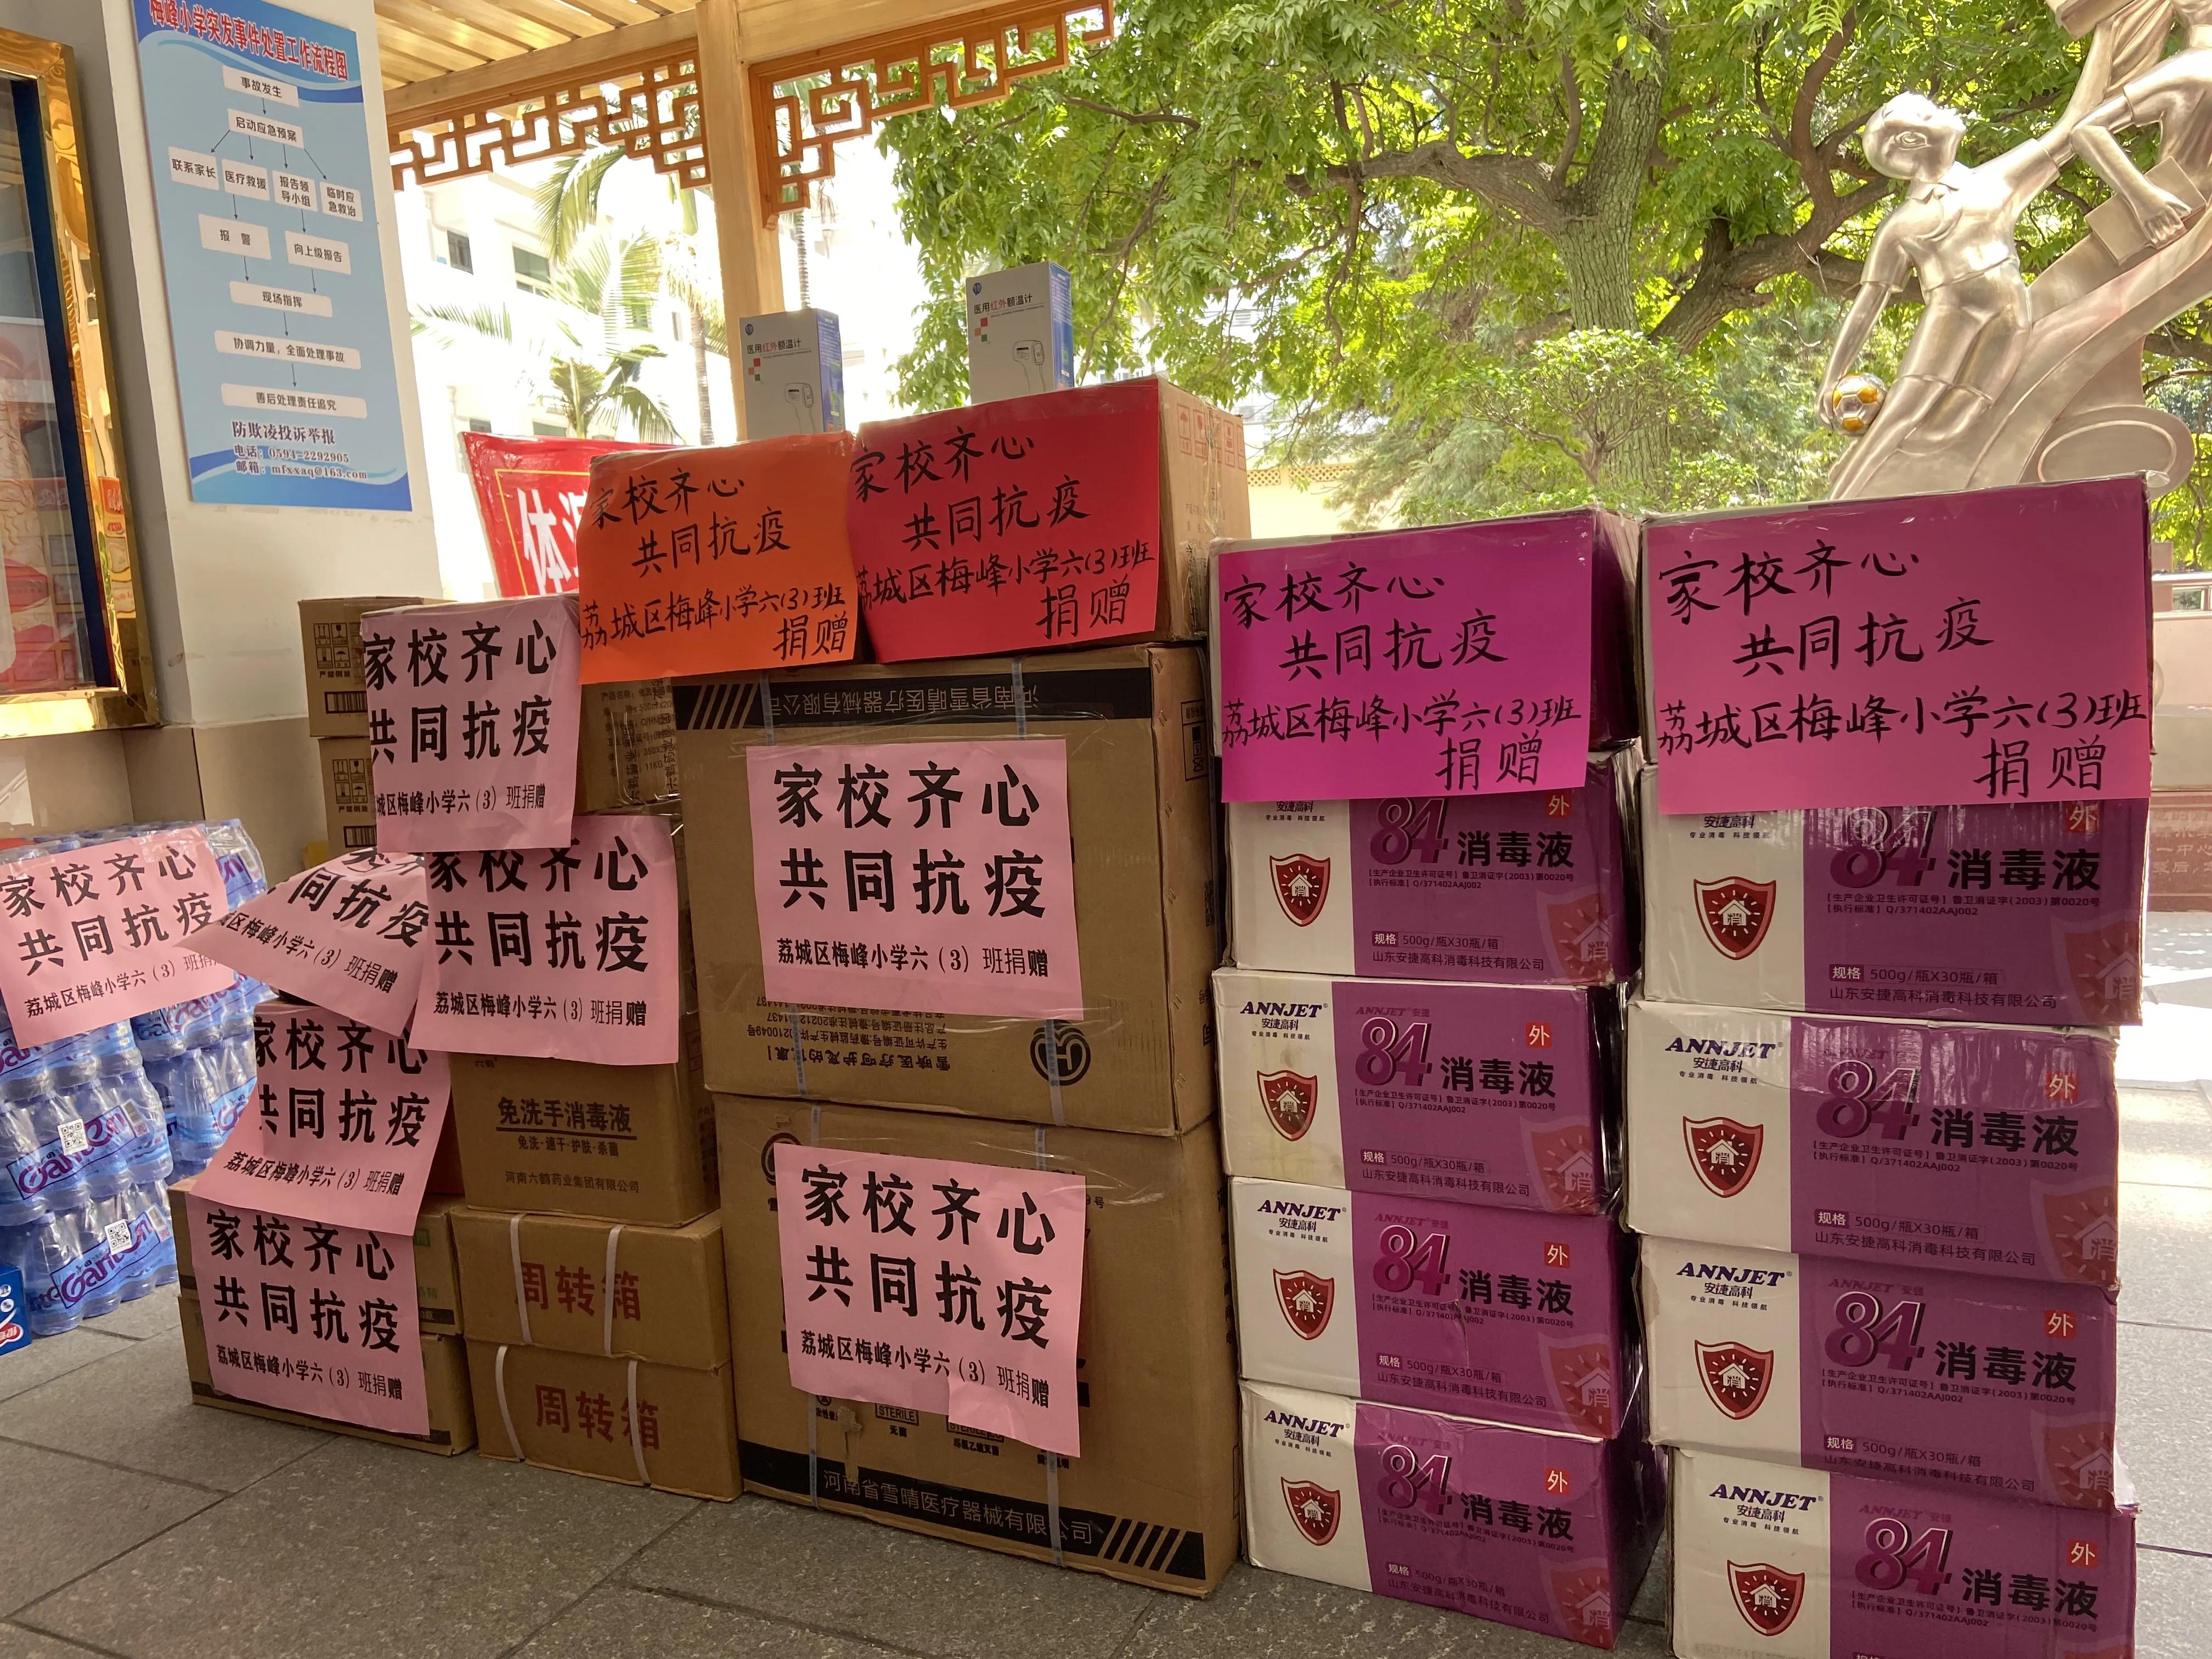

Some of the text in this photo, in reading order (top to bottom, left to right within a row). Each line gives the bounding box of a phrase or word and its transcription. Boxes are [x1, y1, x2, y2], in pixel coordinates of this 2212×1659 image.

[149, 0, 349, 81] 梅峰小学突发事件处置工作流程图
[241, 77, 282, 98] 事故发生
[236, 117, 297, 142] 启动应急预案
[172, 159, 216, 179] 联系家长
[225, 170, 267, 191] 医疗救援
[280, 175, 309, 194] 报告领
[326, 187, 354, 203] 临时应
[281, 191, 311, 207] 导小组
[328, 201, 356, 217] 急救治
[295, 243, 342, 263] 向上级报告
[262, 291, 302, 309] 现场指挥
[974, 294, 1032, 314] 医用红外额温计
[747, 338, 801, 354] 医用红外额温计
[256, 392, 337, 411] 善后处理责任追究
[232, 421, 335, 445] 防欺凌投诉举报
[850, 426, 1035, 503] 家校齐心
[590, 468, 744, 529] 家校齐心
[901, 475, 1091, 551] 共同抗疫
[631, 506, 790, 577] 共同抗疫
[1224, 561, 1444, 629] 家校齐心
[1658, 539, 1919, 625] 家校齐心
[1035, 574, 1130, 640] 捐赠
[772, 610, 848, 661] 捐赠
[1278, 608, 1509, 681] 共同抗疫
[1733, 597, 1995, 678] 共同抗疫
[363, 619, 557, 691] 家校齐心
[770, 684, 1039, 718] 河南省雪晴医疗器械有限公司
[370, 695, 552, 764] 共同抗疫
[1435, 730, 1543, 791] 捐赠
[1973, 735, 2107, 799] 捐赠
[774, 760, 1039, 828] 家校齐心
[1548, 794, 1570, 816] 外
[1704, 815, 1755, 829] 安捷高科
[2069, 804, 2096, 830] 外
[1371, 797, 1575, 868] 84 消毒液
[1830, 806, 2101, 891] 84 消毒液
[428, 836, 648, 893] 家校齐心
[0, 845, 196, 918] 家校齐心
[779, 848, 1045, 918] 共同抗疫
[267, 867, 429, 948] 同抗疫
[18, 892, 212, 977] 共同抗疫
[435, 910, 649, 972] 共同抗疫
[1374, 933, 1397, 945] 规格
[1373, 952, 1544, 971] 山东安捷高科消毒科技有限公司
[1832, 967, 1861, 980] 规格
[1240, 1001, 1322, 1018] ANNJET
[1830, 988, 2057, 1009] 山东安捷高科消毒科技有限公司
[1261, 1018, 1299, 1031] 安捷高科
[1528, 1025, 1550, 1046] 外
[253, 1016, 428, 1074] 家校齐心
[1355, 1017, 1556, 1098] 84 消毒液
[1665, 1038, 1775, 1059] ANNJET
[1693, 1058, 1743, 1073] 安捷高科
[2049, 1074, 2076, 1099] 外
[258, 1084, 430, 1148] 共同抗疫
[498, 1096, 632, 1133] 免洗手消毒液
[1816, 1060, 2079, 1156] 84 消毒液
[1363, 1151, 1385, 1164] 规格
[505, 1170, 639, 1194] 河南六鹤药业集团有限公司
[1362, 1169, 1530, 1197] 山东安捷高科消毒科技有限公司
[802, 1164, 1055, 1255] 家校齐心
[1257, 1200, 1341, 1221] ANNJET
[1818, 1211, 1846, 1226] 规格
[1279, 1217, 1317, 1233] 安捷高科
[206, 1209, 395, 1280] 家校齐心
[1547, 1245, 1568, 1266] 外
[1815, 1231, 2036, 1267] 山东安捷高科消毒科技有限公司
[1373, 1225, 1575, 1316] 84 消毒液
[1676, 1262, 1785, 1287] ANNJET
[514, 1261, 641, 1322] 周转箱
[806, 1245, 1052, 1349] 共同抗疫
[1704, 1283, 1753, 1299] 安捷高科
[213, 1276, 399, 1353] 共同抗疫
[2048, 1312, 2074, 1336] 外
[1825, 1291, 2077, 1392] 84 消毒液
[1378, 1355, 1401, 1368] 规格
[1378, 1372, 1547, 1408] 山东安捷高科消毒科技有限公司
[535, 1384, 659, 1451] 周转箱
[879, 1406, 915, 1421] STERILE
[1263, 1410, 1345, 1437] ANNJET
[1284, 1429, 1320, 1447] 安捷高科
[1826, 1436, 1854, 1451] 规格
[1547, 1470, 1568, 1493] 外
[1824, 1454, 2035, 1492] 山东安捷高科消毒科技有限公司
[1377, 1445, 1574, 1541] 84 消毒液
[1709, 1483, 1817, 1511] ANNJET
[1736, 1504, 1786, 1524] 安捷高科
[2070, 1542, 2095, 1565] 外
[1389, 1563, 1409, 1577] 规格
[1855, 1517, 2098, 1620] 84 消毒液
